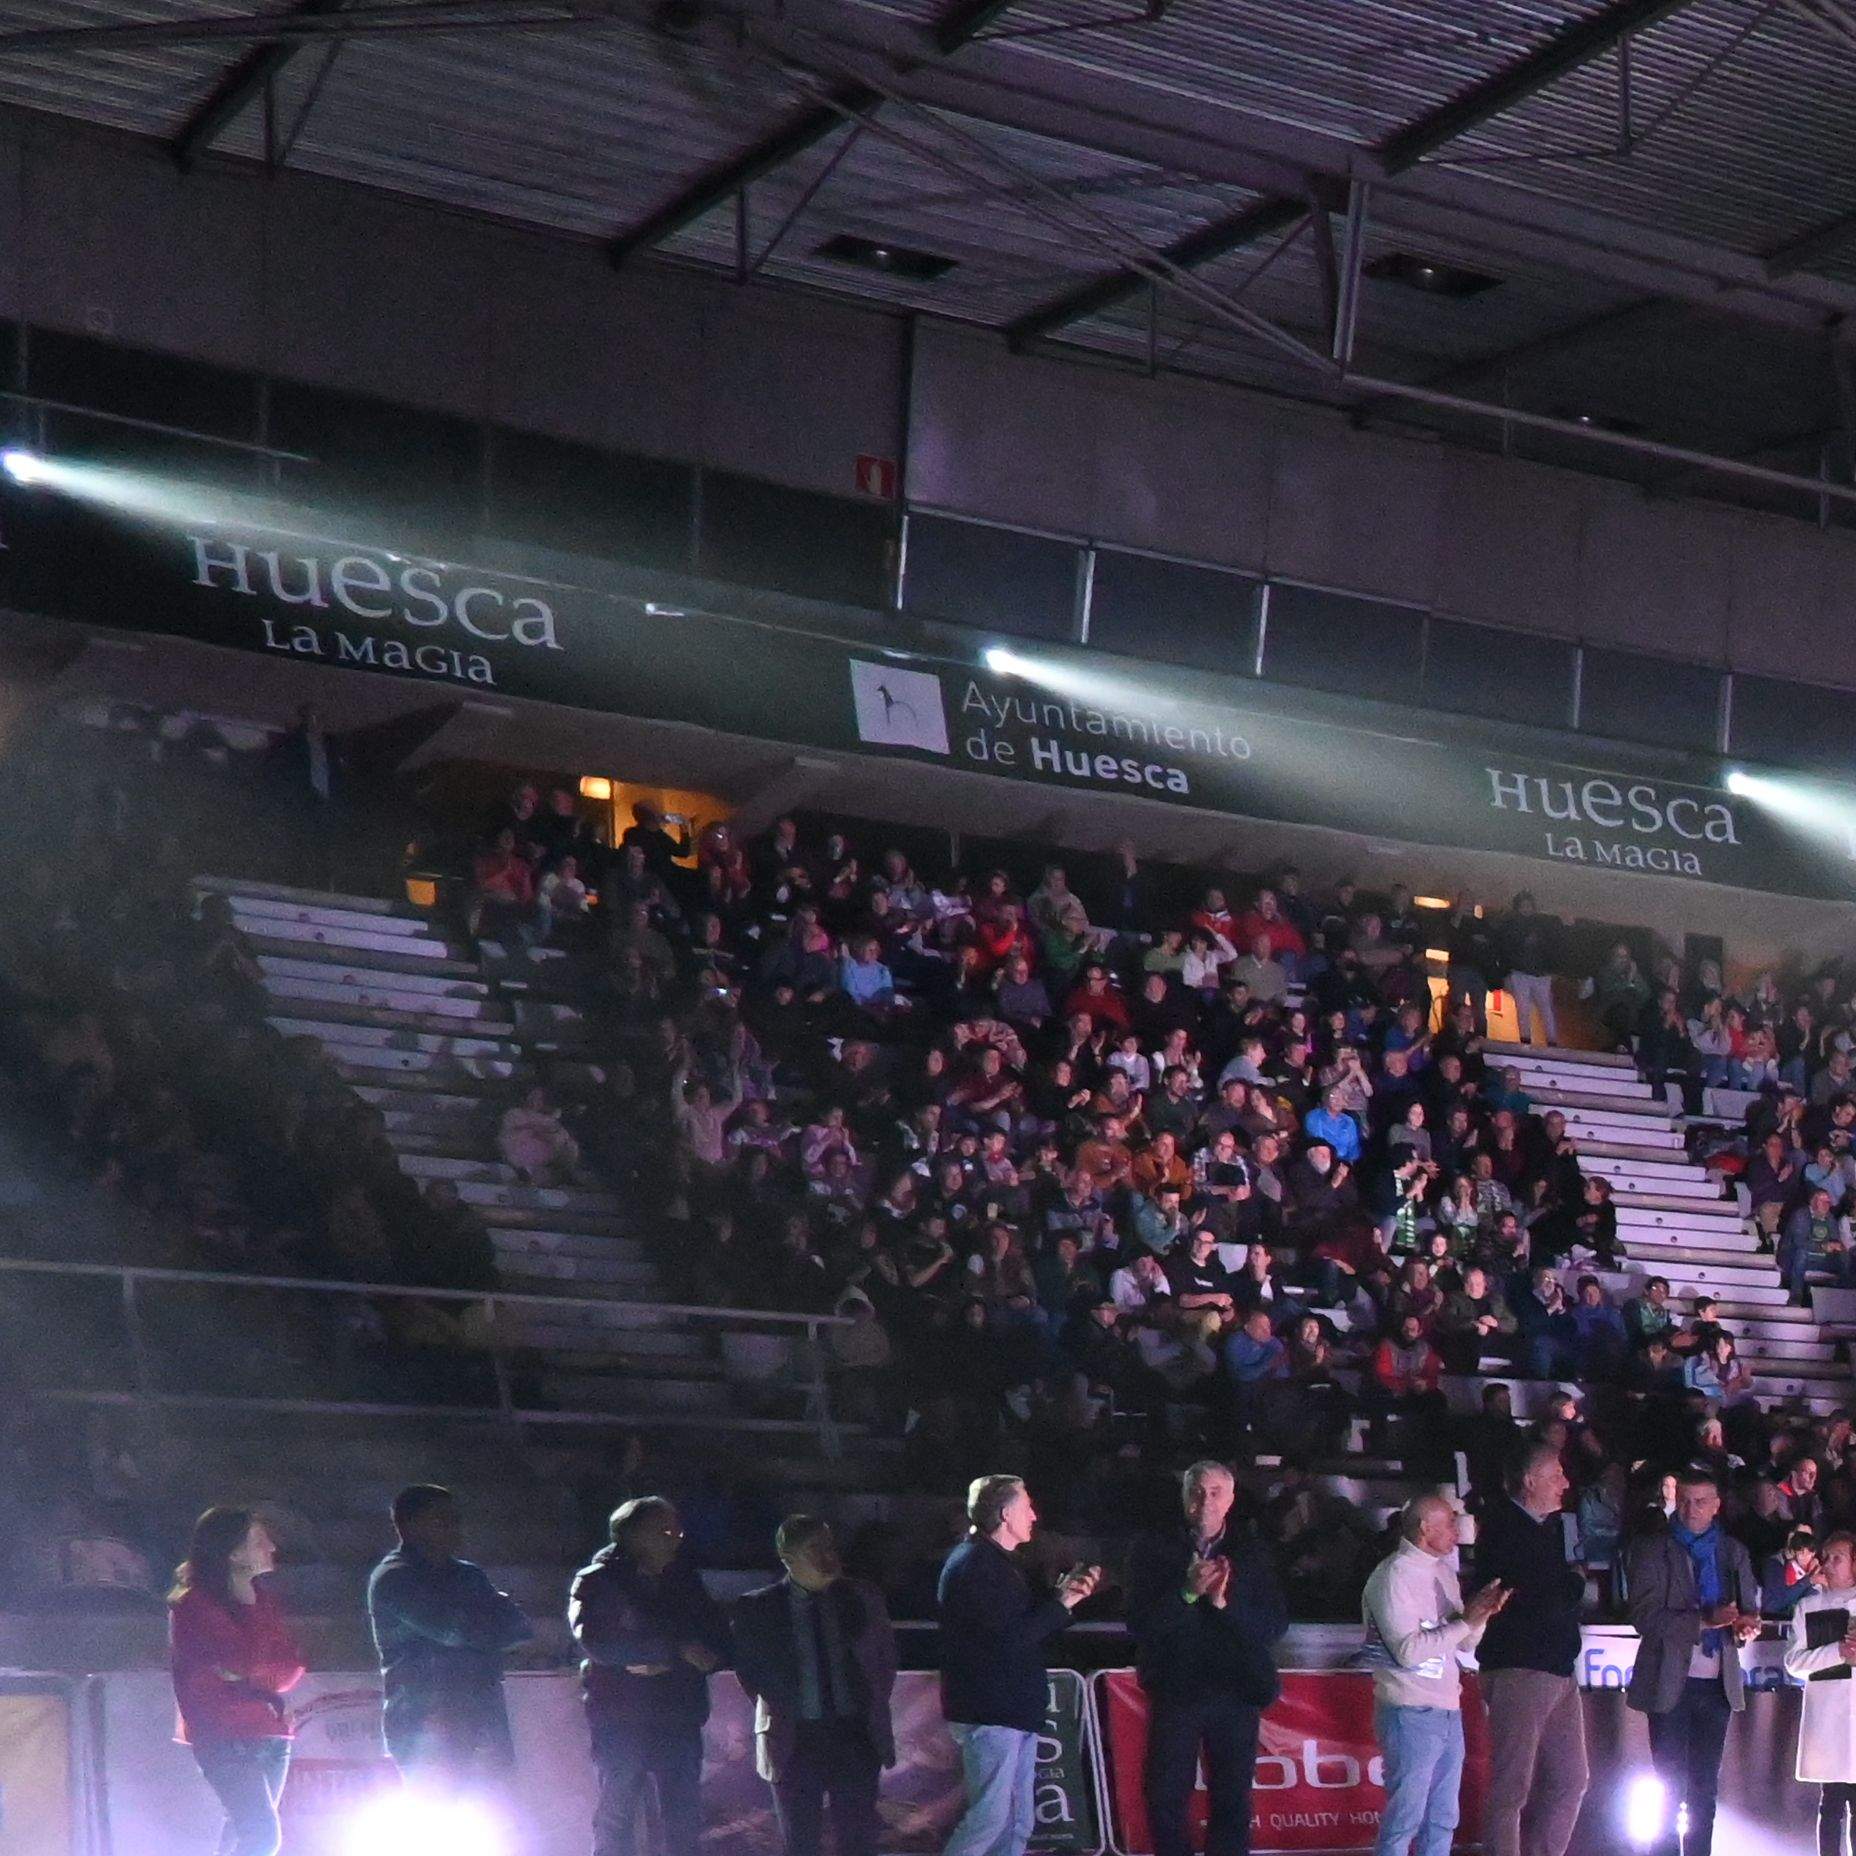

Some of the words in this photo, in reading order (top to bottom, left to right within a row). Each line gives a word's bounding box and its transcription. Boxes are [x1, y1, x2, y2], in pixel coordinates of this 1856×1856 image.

[188, 536, 565, 651] Huesca
[262, 618, 323, 655] La
[962, 681, 1252, 761] Ayuntamiento
[967, 731, 1015, 765] de
[1032, 738, 1190, 795] Huesca
[1486, 768, 1742, 846] Huesca
[1546, 834, 1588, 861] La
[1270, 1811, 1339, 1830] QUALITY
